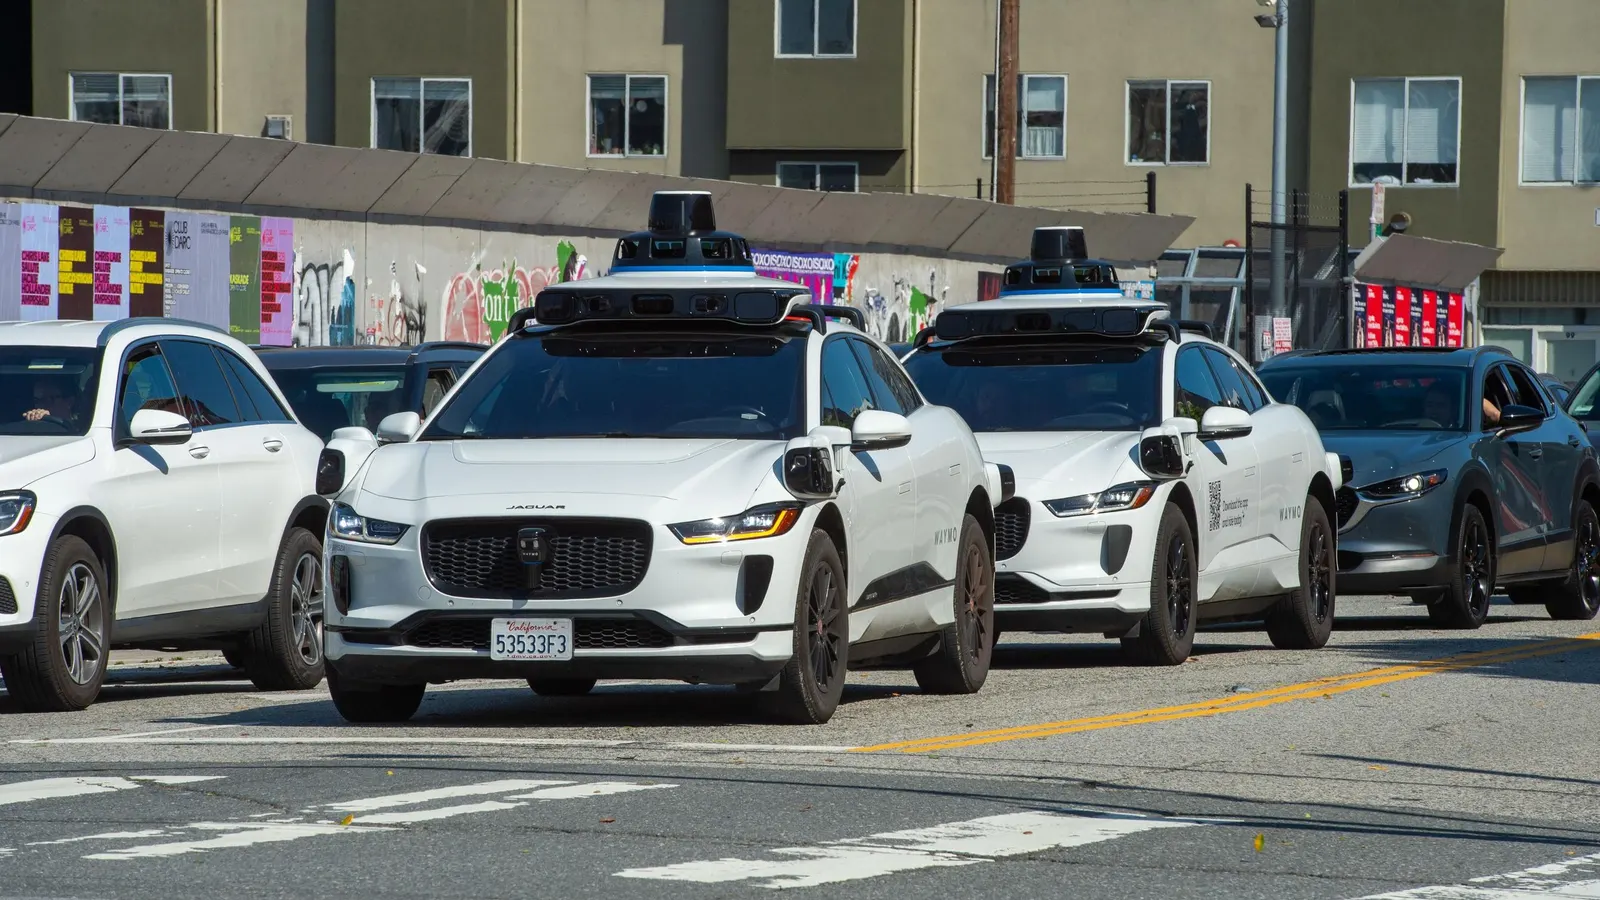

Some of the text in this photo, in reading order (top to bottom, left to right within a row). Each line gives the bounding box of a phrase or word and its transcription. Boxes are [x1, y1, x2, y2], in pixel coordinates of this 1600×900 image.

[174, 221, 188, 234] CLUB
[175, 235, 191, 249] DARC
[1279, 505, 1301, 521] WAYMO
[934, 526, 958, 545] WAYMO
[508, 621, 557, 633] California
[496, 634, 566, 654] 53533F3
